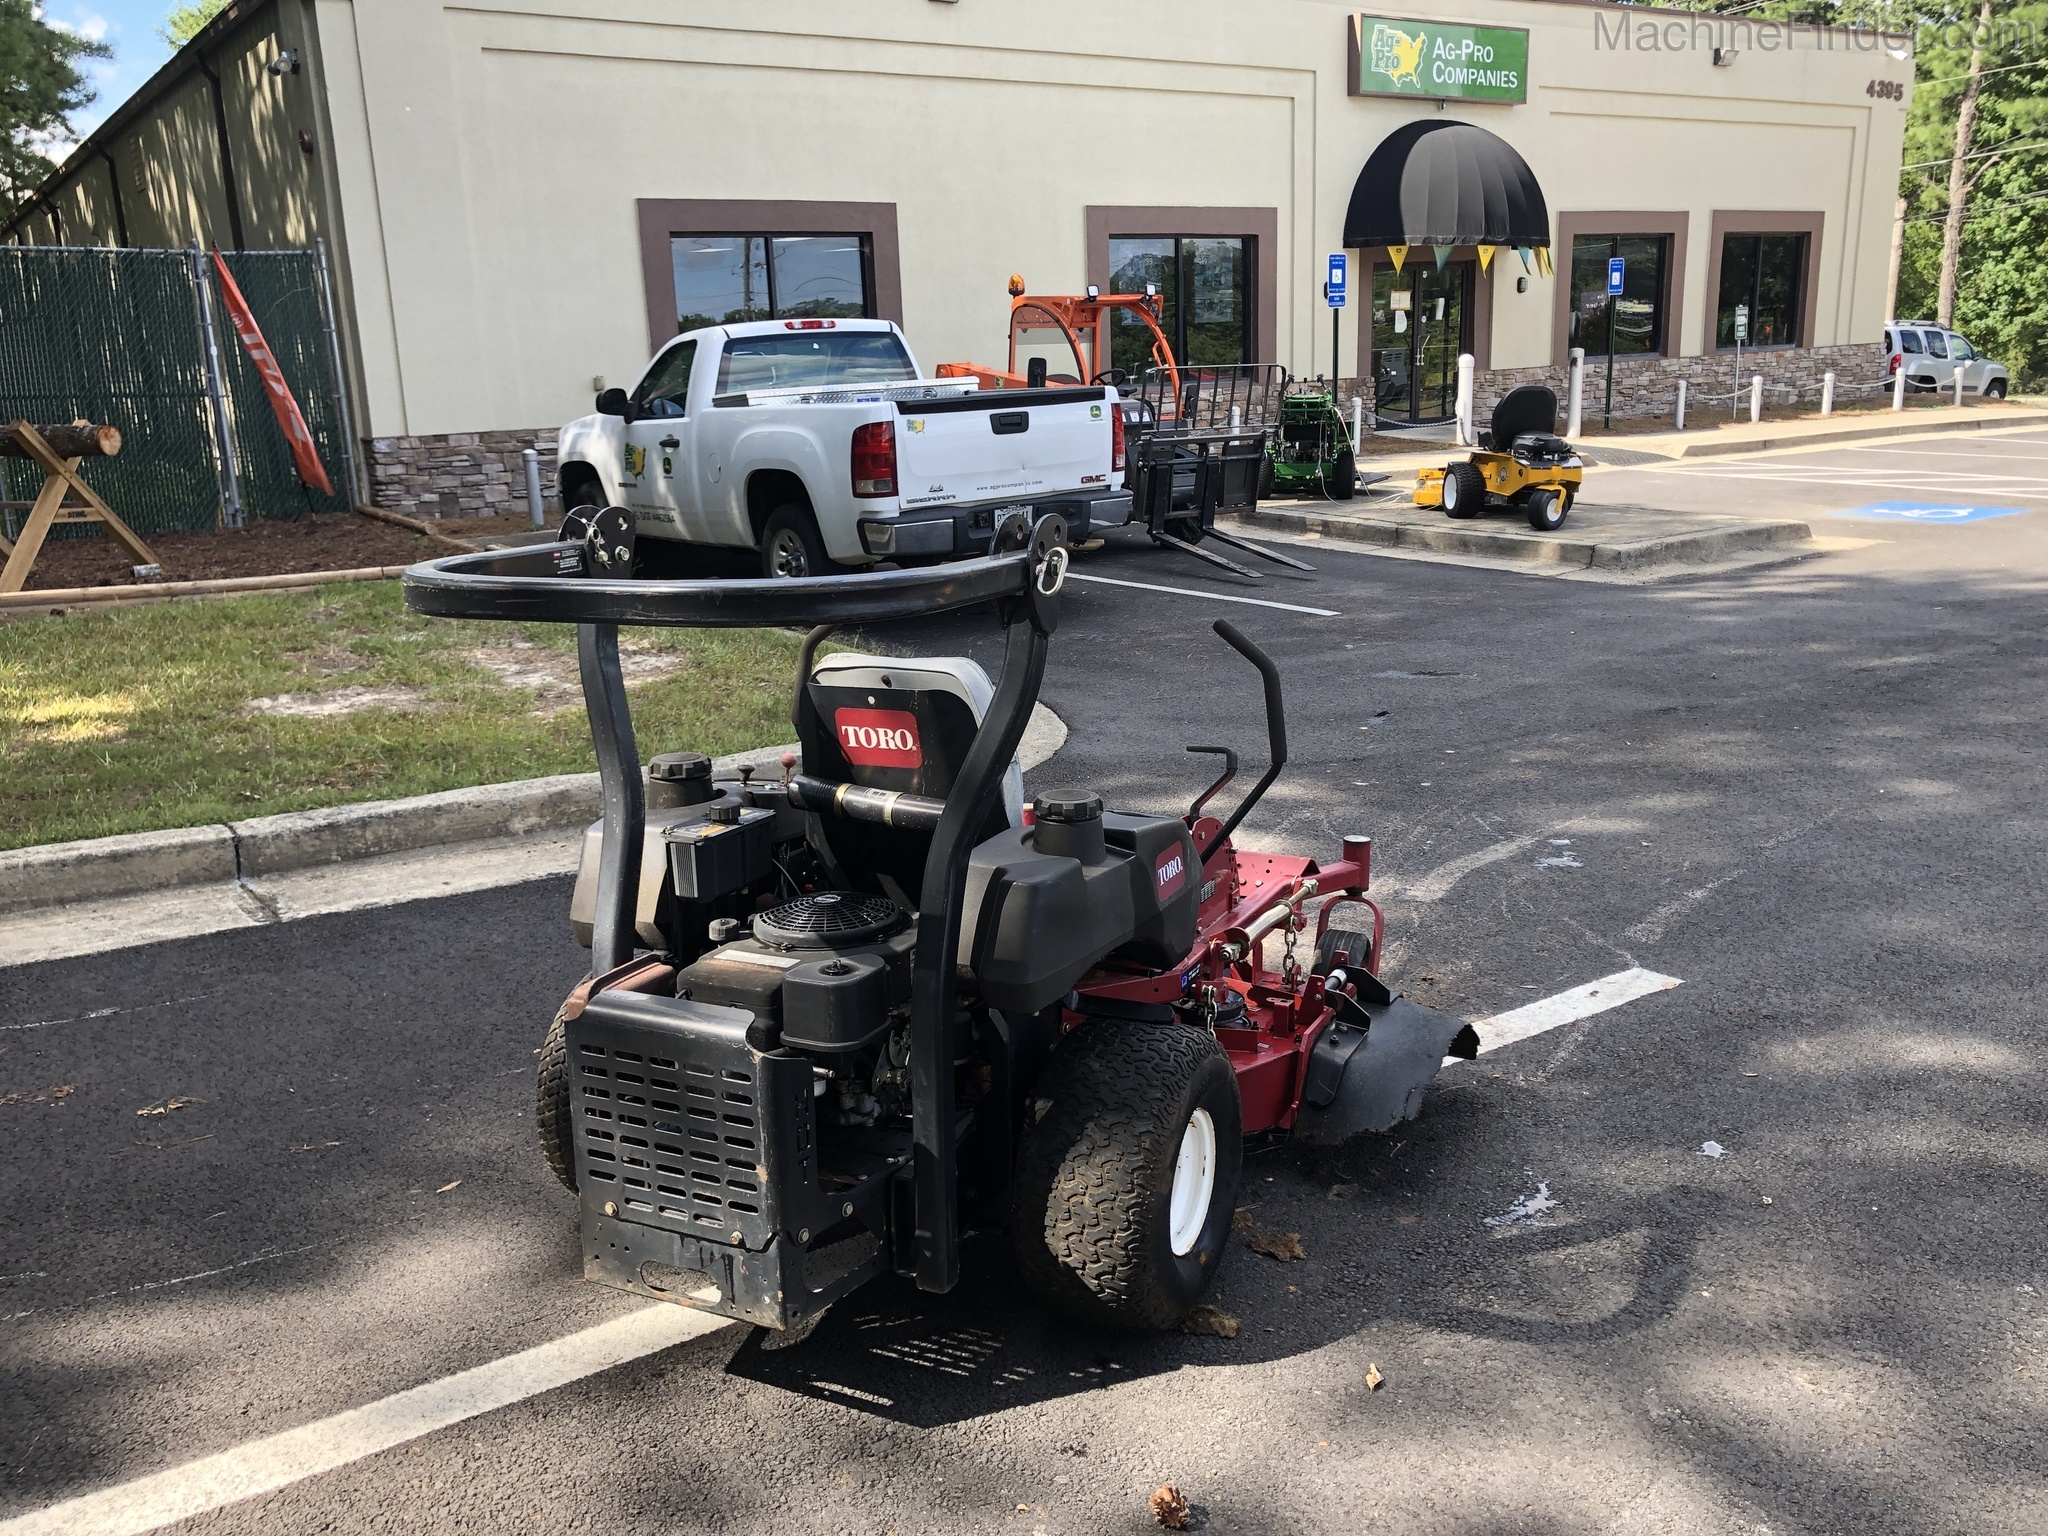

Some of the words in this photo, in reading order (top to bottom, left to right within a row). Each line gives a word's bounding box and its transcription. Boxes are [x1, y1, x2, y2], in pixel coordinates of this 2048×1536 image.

[1866, 79, 1904, 101] 4395
[976, 480, 1043, 491] www.agprocompans.com
[1081, 474, 1106, 484] GMC
[841, 725, 915, 751] TORO
[1158, 856, 1182, 886] TORO
